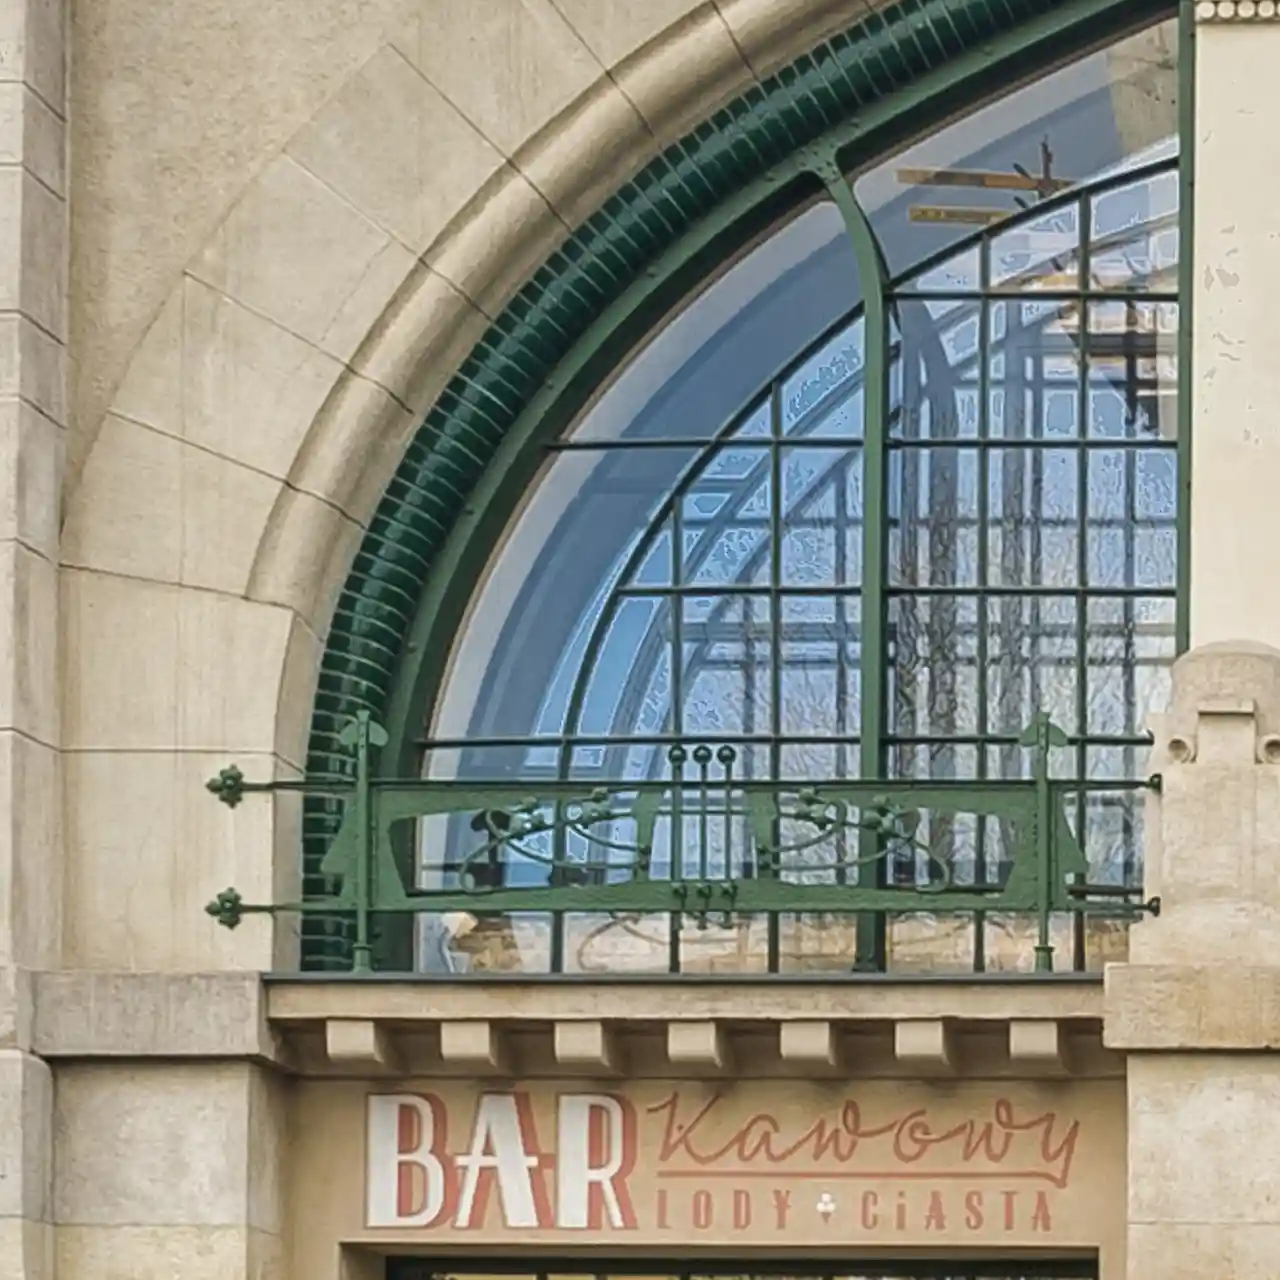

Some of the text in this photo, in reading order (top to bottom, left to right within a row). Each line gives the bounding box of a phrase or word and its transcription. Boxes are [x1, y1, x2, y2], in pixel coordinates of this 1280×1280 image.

[365, 1090, 1080, 1229] BAR Kawowy
[656, 1189, 793, 1230] LODY
